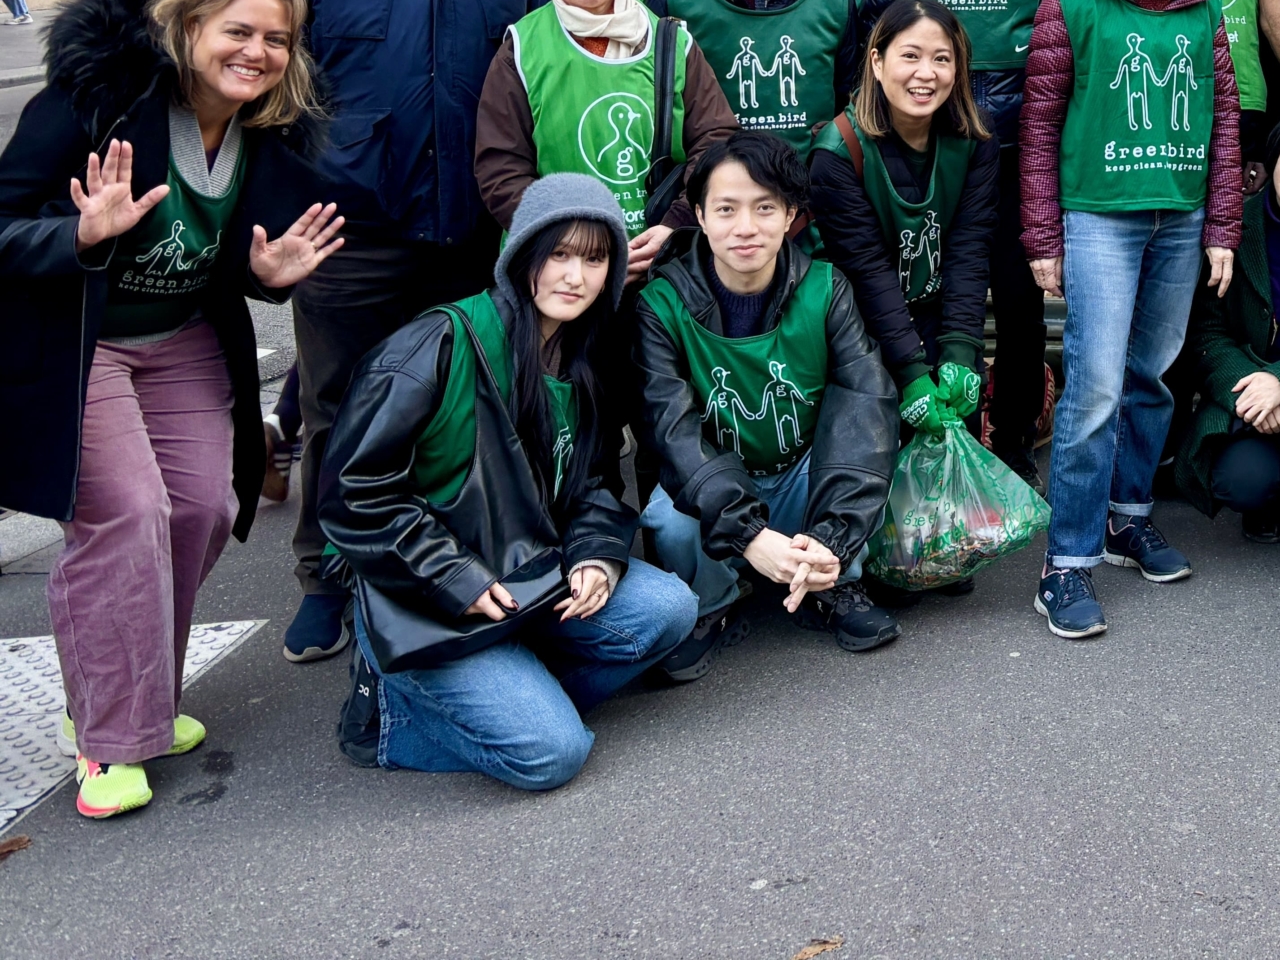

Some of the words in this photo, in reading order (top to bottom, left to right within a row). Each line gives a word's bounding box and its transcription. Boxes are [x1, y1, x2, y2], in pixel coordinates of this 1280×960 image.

[1224, 15, 1247, 25] bird
[743, 54, 751, 66] g
[783, 52, 790, 65] g
[1131, 55, 1141, 72] g
[1178, 57, 1187, 73] g
[778, 111, 807, 122] bird
[1167, 142, 1205, 159] bird
[617, 146, 634, 177] g
[1105, 164, 1131, 172] keep
[122, 269, 177, 288] green
